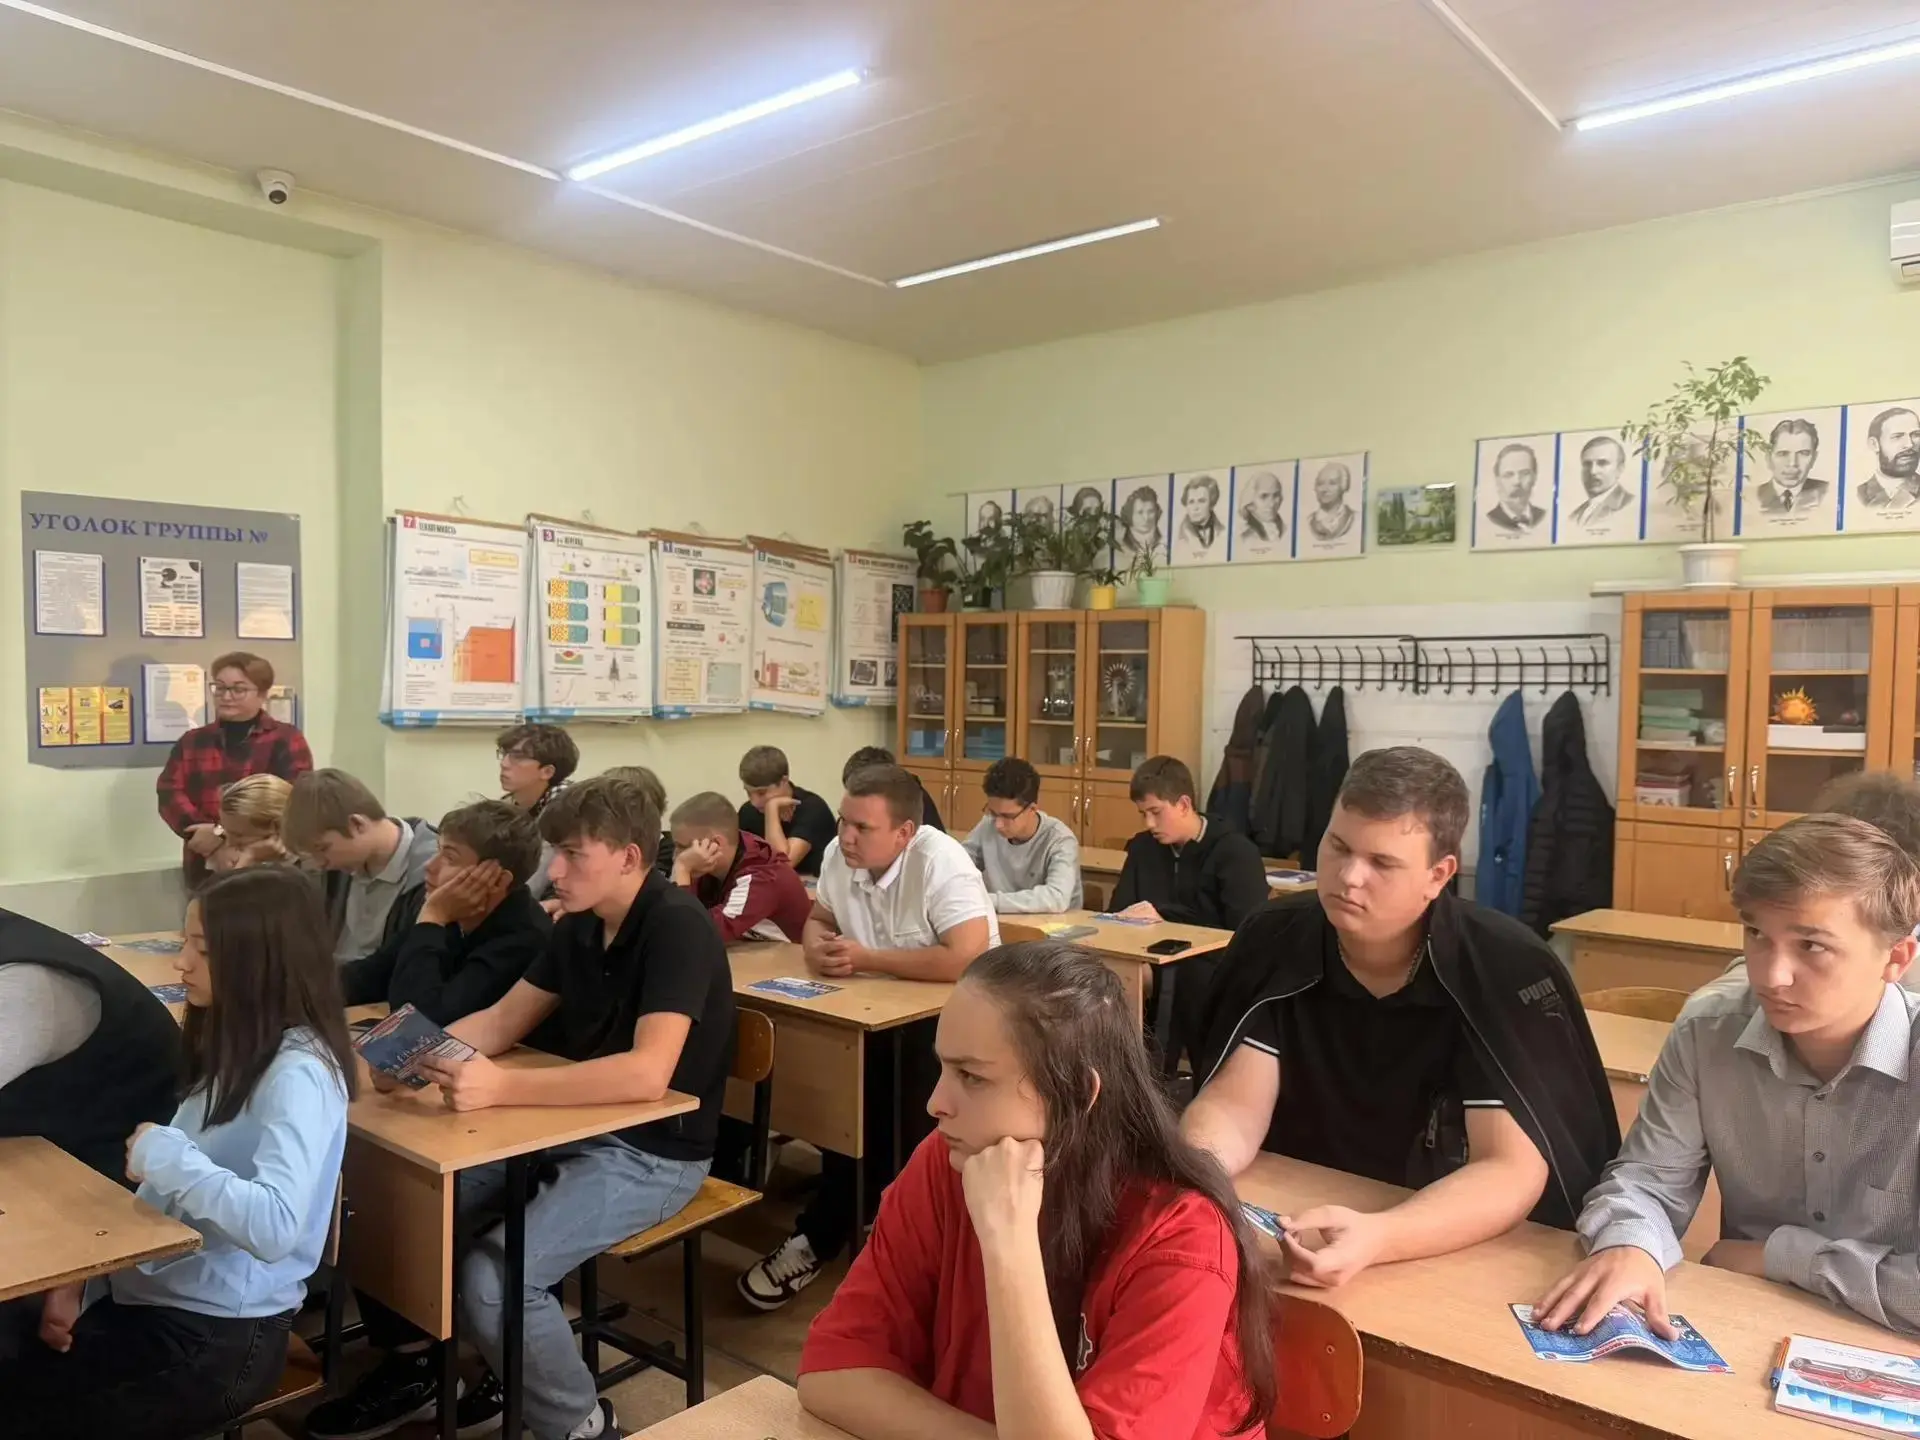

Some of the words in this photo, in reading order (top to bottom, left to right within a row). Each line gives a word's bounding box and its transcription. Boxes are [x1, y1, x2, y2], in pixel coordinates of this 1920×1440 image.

[29, 512, 138, 535] УГОЛОК
[143, 521, 244, 542] ГРУППЫ
[249, 529, 268, 544] №
